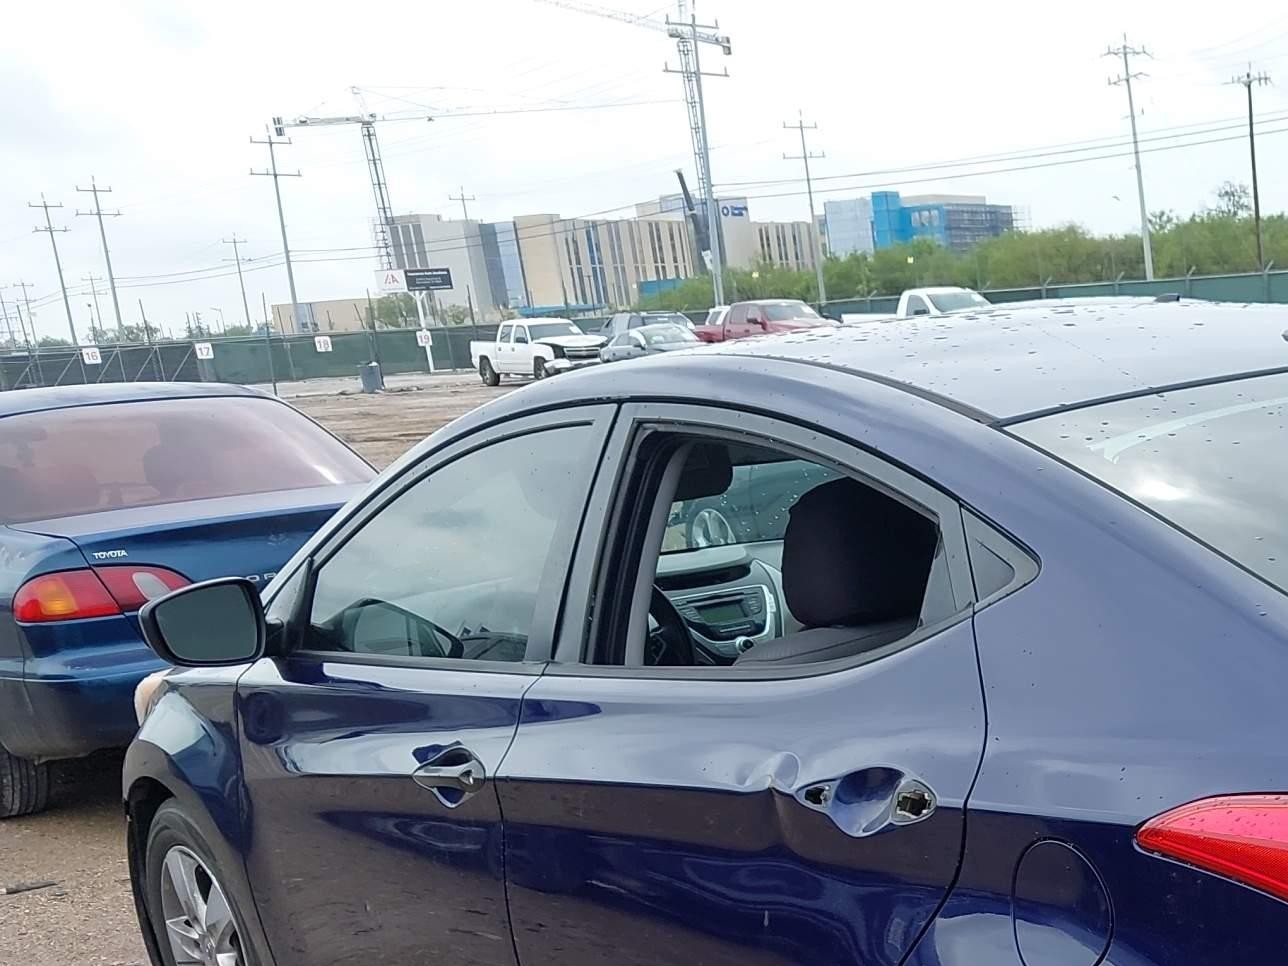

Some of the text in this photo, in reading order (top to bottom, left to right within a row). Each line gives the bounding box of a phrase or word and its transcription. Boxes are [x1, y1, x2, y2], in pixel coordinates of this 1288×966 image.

[317, 338, 330, 350] 18
[418, 334, 430, 345] 19
[86, 351, 99, 361] 16
[199, 346, 211, 357] 17
[92, 549, 129, 560] TOYOTA
